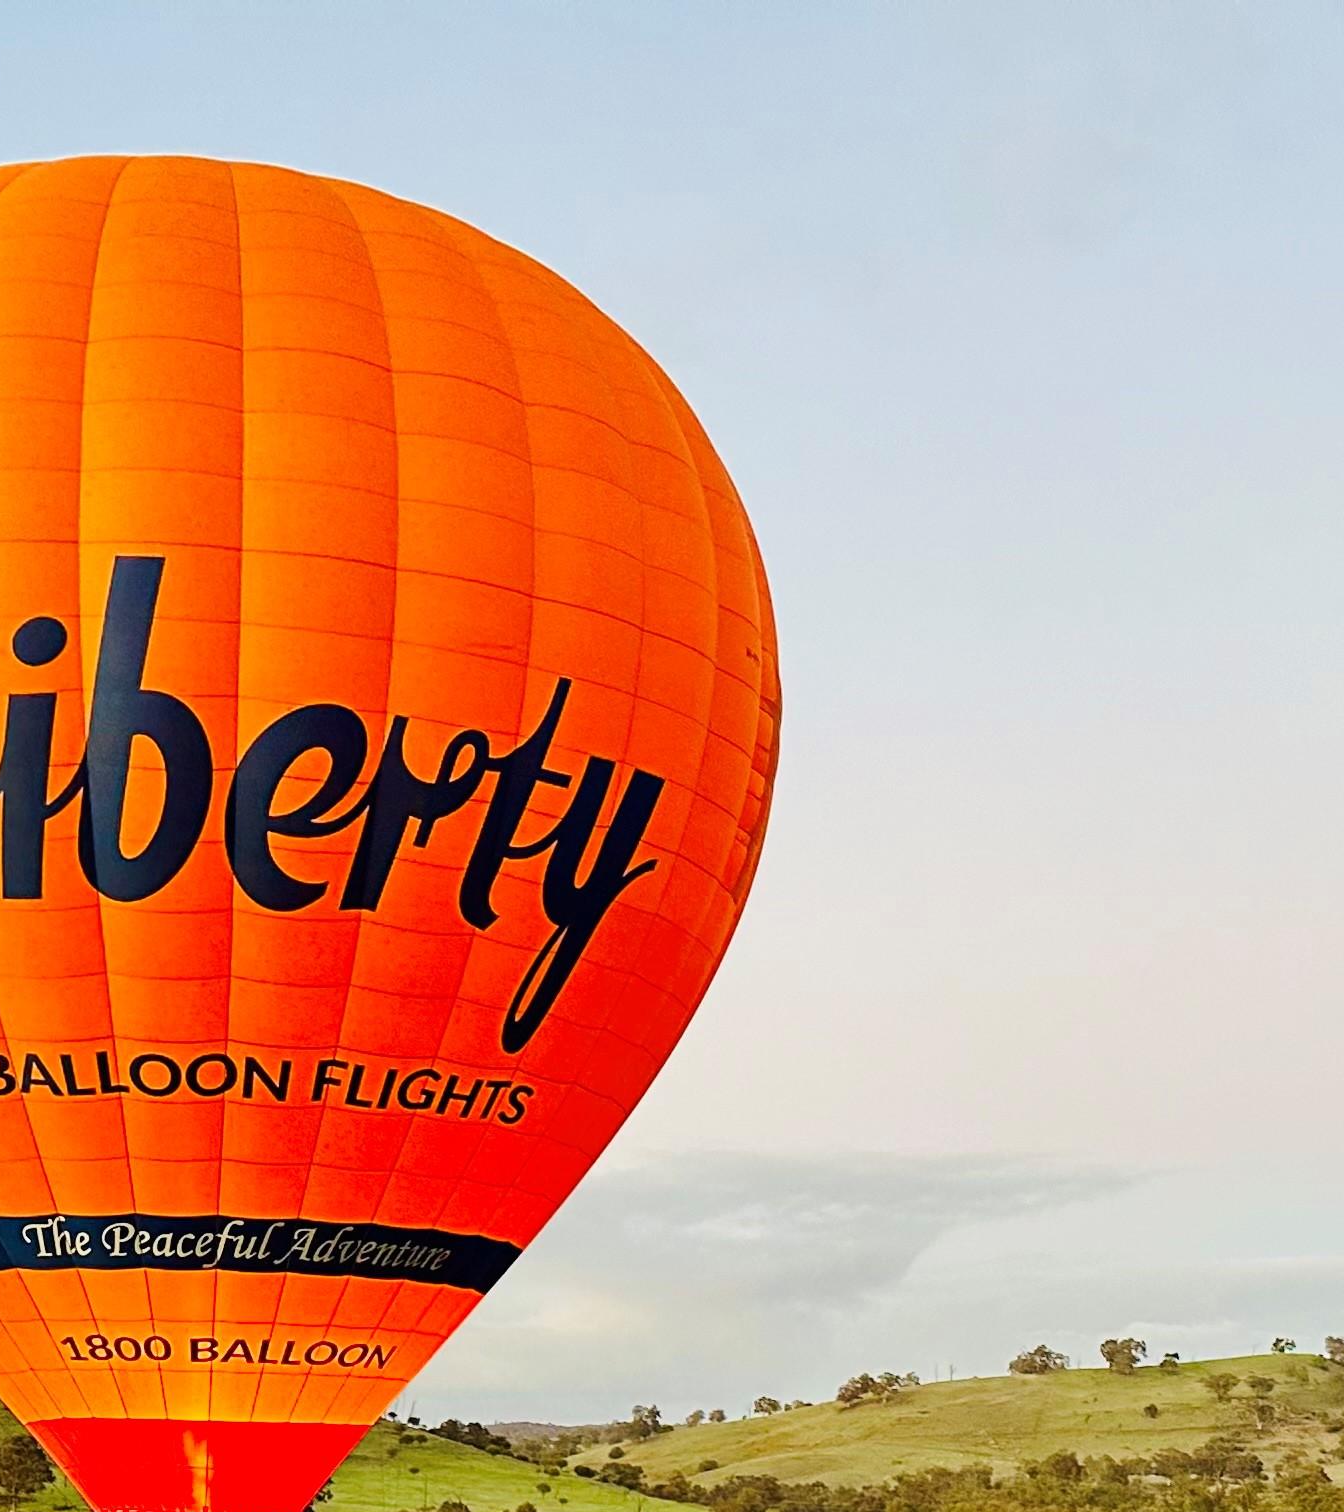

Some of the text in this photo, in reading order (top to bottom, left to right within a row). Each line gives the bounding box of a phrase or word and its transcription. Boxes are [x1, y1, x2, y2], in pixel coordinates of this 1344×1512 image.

[311, 1058, 536, 1125] FLIGHTS
[22, 1216, 451, 1270] The Peaceful Adventure
[61, 1334, 398, 1369] 1800 BALLOON
